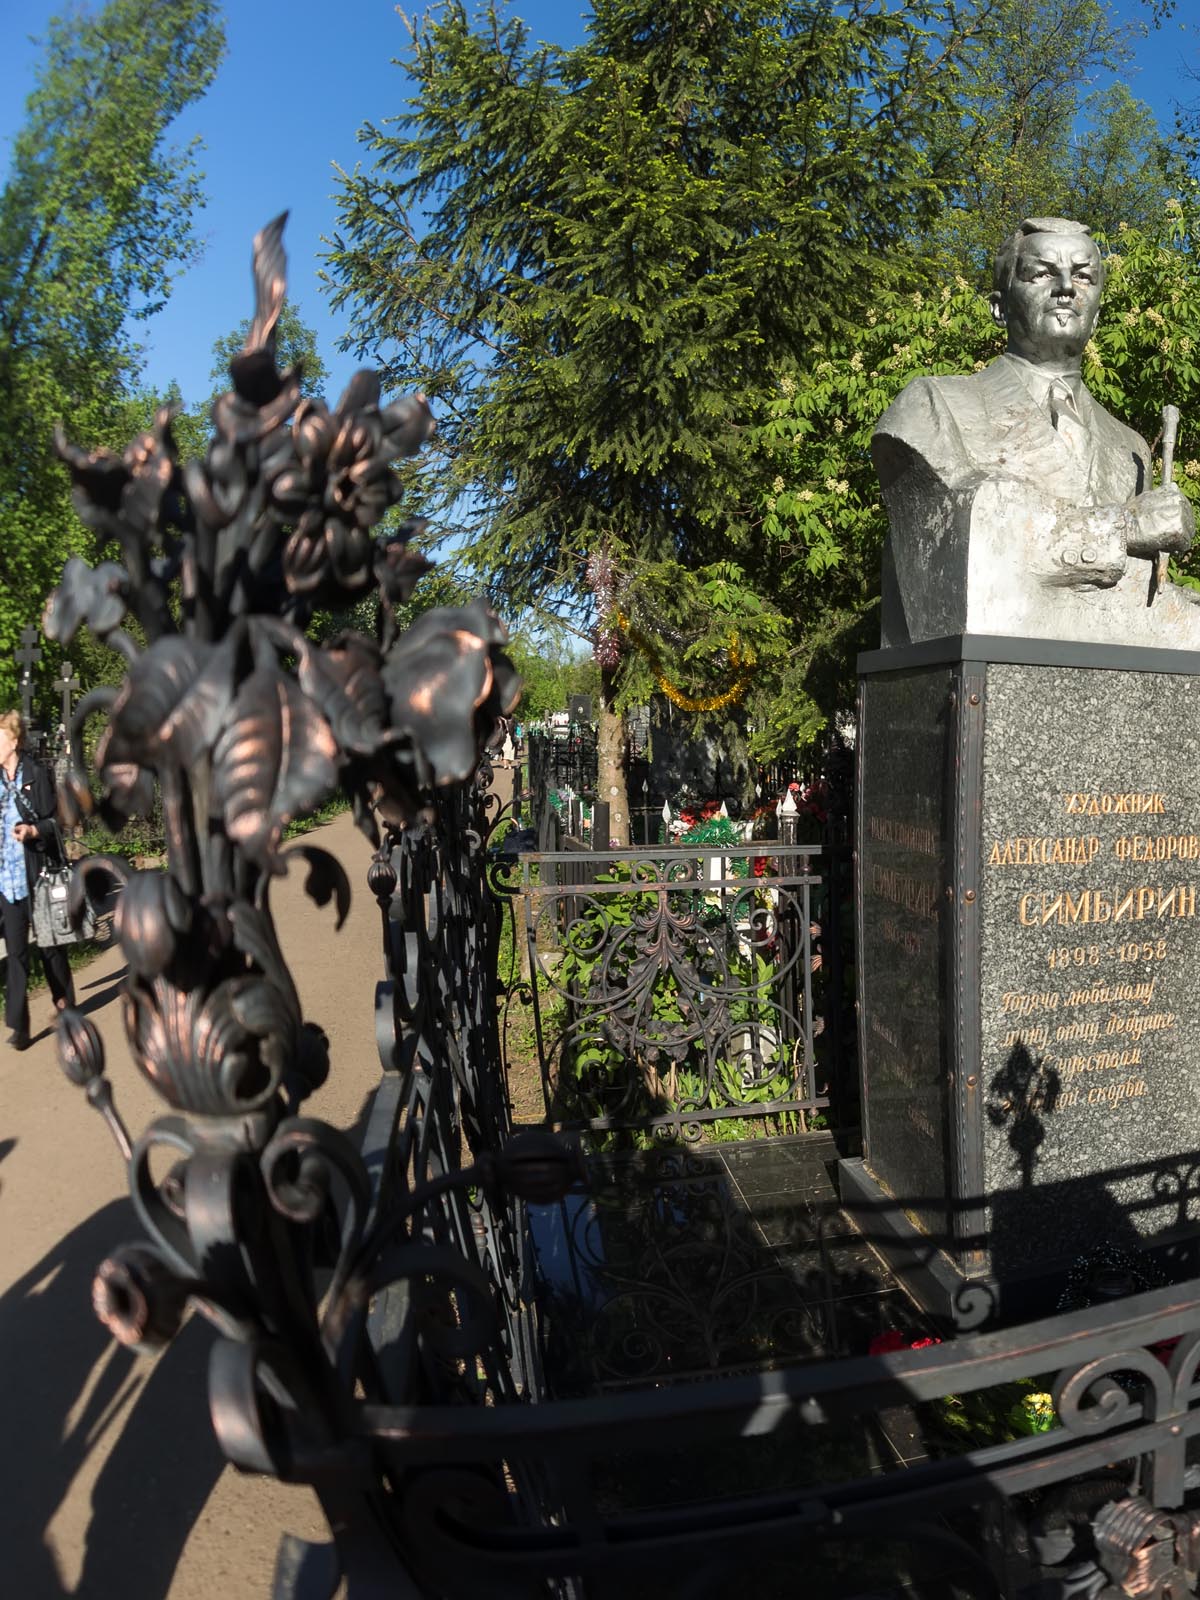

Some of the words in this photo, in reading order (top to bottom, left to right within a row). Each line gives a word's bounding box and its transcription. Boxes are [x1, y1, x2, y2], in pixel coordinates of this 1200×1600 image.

[1065, 793, 1167, 815] ХУДОЖНИК
[987, 836, 1100, 865] АЛЕКСАНДР
[1018, 883, 1197, 926] СИМБИРИН
[1001, 990, 1059, 1016] Горячо
[1063, 976, 1156, 1007] любимому
[1058, 1047, 1142, 1082] чувством
